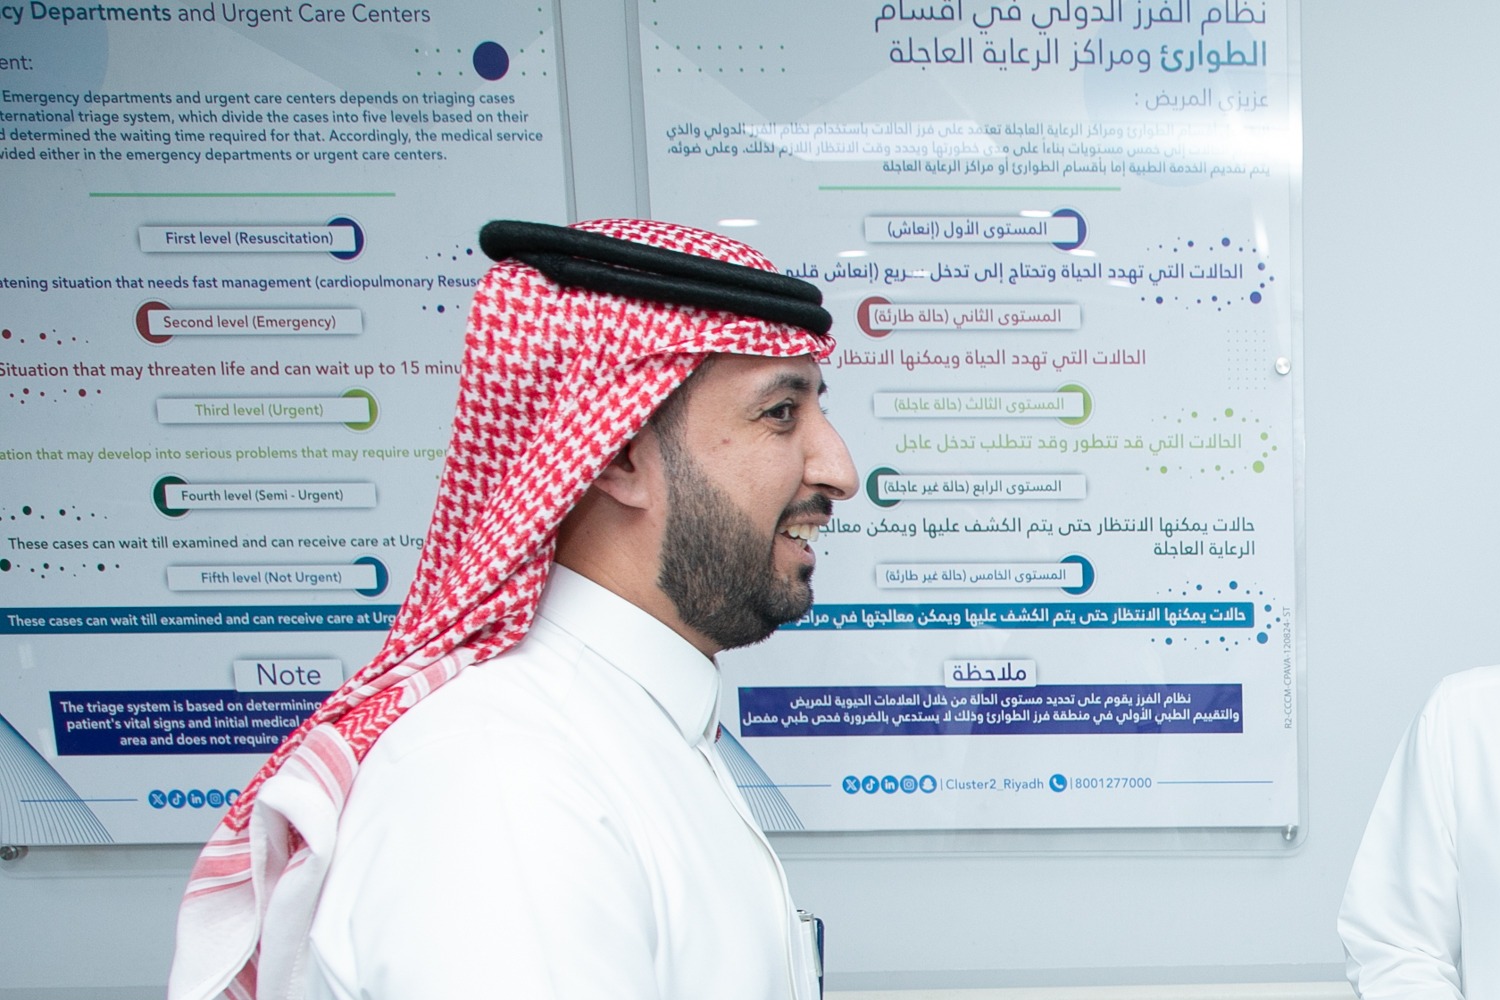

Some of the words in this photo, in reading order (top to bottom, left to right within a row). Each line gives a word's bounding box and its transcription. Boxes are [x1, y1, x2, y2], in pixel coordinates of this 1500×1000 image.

[0, 5, 24, 26] cy
[29, 0, 172, 26] Departments
[178, 1, 216, 22] and
[221, 2, 294, 28] Urgent
[298, 2, 346, 23] Care
[351, 2, 431, 23] Centers
[889, 36, 973, 71] العاجلة
[982, 37, 1059, 72] الرعاية
[1069, 37, 1151, 73] ومراكز
[1160, 39, 1267, 74] الطوارئ
[1, 89, 80, 107] Emergency
[83, 89, 173, 107] departments
[175, 90, 202, 104] and
[204, 92, 251, 107] urgent
[253, 94, 283, 105] care
[285, 92, 337, 105] centers
[339, 90, 399, 107] depends
[401, 94, 419, 105] on
[421, 91, 476, 107] triaging
[478, 94, 516, 105] cases
[887, 220, 940, 240] (إنعاش)
[943, 218, 979, 239] الأول
[983, 221, 1048, 240] المستوى
[165, 231, 197, 245] First
[199, 230, 232, 245] level
[234, 231, 334, 247] (Resuscitation)
[51, 275, 113, 289] situation
[114, 275, 145, 289] that
[147, 275, 190, 289] needs
[191, 274, 219, 289] fast
[221, 276, 312, 291] management
[314, 274, 434, 290] (cardiopulmonary
[163, 314, 214, 329] Second
[216, 314, 249, 328] level
[252, 314, 336, 332] (Emergency)
[873, 309, 915, 328] طارئة)
[917, 309, 949, 328] (حالة
[952, 308, 994, 330] الثاني
[997, 308, 1062, 327] المستوى
[72, 361, 107, 377] that
[110, 365, 144, 381] may
[147, 360, 217, 377] threaten
[220, 360, 246, 376] life
[250, 360, 280, 376] and
[284, 365, 312, 376] can
[315, 360, 350, 376] wait
[354, 364, 375, 379] up
[378, 362, 396, 375] to
[400, 360, 420, 375] 15
[194, 403, 230, 417] Third
[232, 402, 265, 417] level
[268, 403, 324, 420] (Urgent)
[893, 397, 931, 414] عاجلة)
[933, 396, 962, 413] (حالة
[965, 396, 1002, 411] الثالث
[1005, 396, 1065, 414] المستوى
[895, 433, 932, 454] عاجل
[936, 433, 976, 454] تدخل
[979, 433, 1033, 453] تتطلب
[1037, 435, 1068, 454] وقد
[1072, 433, 1119, 454] تتطور
[1123, 435, 1144, 449] قد
[1148, 433, 1185, 457] التي
[1188, 432, 1242, 449] الحالات
[35, 448, 64, 461] that
[66, 450, 95, 464] may
[97, 447, 152, 463] develop
[154, 447, 182, 460] into
[184, 447, 233, 460] serious
[235, 445, 298, 462] problems
[300, 445, 329, 459] that
[331, 449, 359, 462] may
[362, 445, 410, 461] require
[181, 489, 222, 502] Fourth
[223, 489, 252, 502] level
[254, 489, 288, 503] (Semi
[297, 489, 344, 504] Urgent)
[883, 480, 918, 495] عاجلة)
[921, 481, 940, 496] غير
[942, 480, 970, 495] (حالة
[972, 479, 1003, 498] الرابع
[1005, 479, 1062, 496] المستوى
[200, 571, 230, 584] Fifth
[232, 571, 262, 584] level
[264, 571, 293, 585] (Not
[294, 571, 342, 586] Urgent)
[885, 569, 919, 584] طارئة)
[921, 570, 939, 584] غير
[941, 569, 967, 583] (حالة
[969, 568, 1012, 584] الخامس
[1014, 568, 1066, 584] المستوى
[6, 614, 46, 627] These
[48, 617, 84, 627] cases
[85, 617, 108, 627] can
[109, 613, 139, 626] wait
[140, 612, 158, 626] till
[160, 612, 223, 626] examined
[225, 611, 250, 626] and
[252, 615, 275, 625] can
[277, 612, 324, 625] receive
[326, 614, 354, 625] care
[356, 612, 371, 624] at
[372, 611, 397, 627] Urg
[256, 662, 321, 686] Note
[952, 661, 1027, 682] ملاحظة
[59, 700, 85, 714] The
[86, 700, 125, 716] triage
[126, 701, 171, 716] system
[172, 699, 184, 713] is
[185, 698, 225, 713] based
[226, 702, 244, 712] on
[66, 717, 122, 733] patient's
[123, 716, 151, 730] vital
[152, 716, 186, 732] signs
[187, 715, 212, 729] and
[213, 715, 249, 729] initial
[251, 714, 301, 733] medical
[119, 736, 148, 746] area
[149, 732, 174, 746] and
[176, 732, 208, 746] does
[209, 733, 232, 745] not
[233, 732, 279, 748] require
[945, 777, 1044, 793] Cluster2_Riyadh
[1075, 777, 1153, 790] 8001277000
